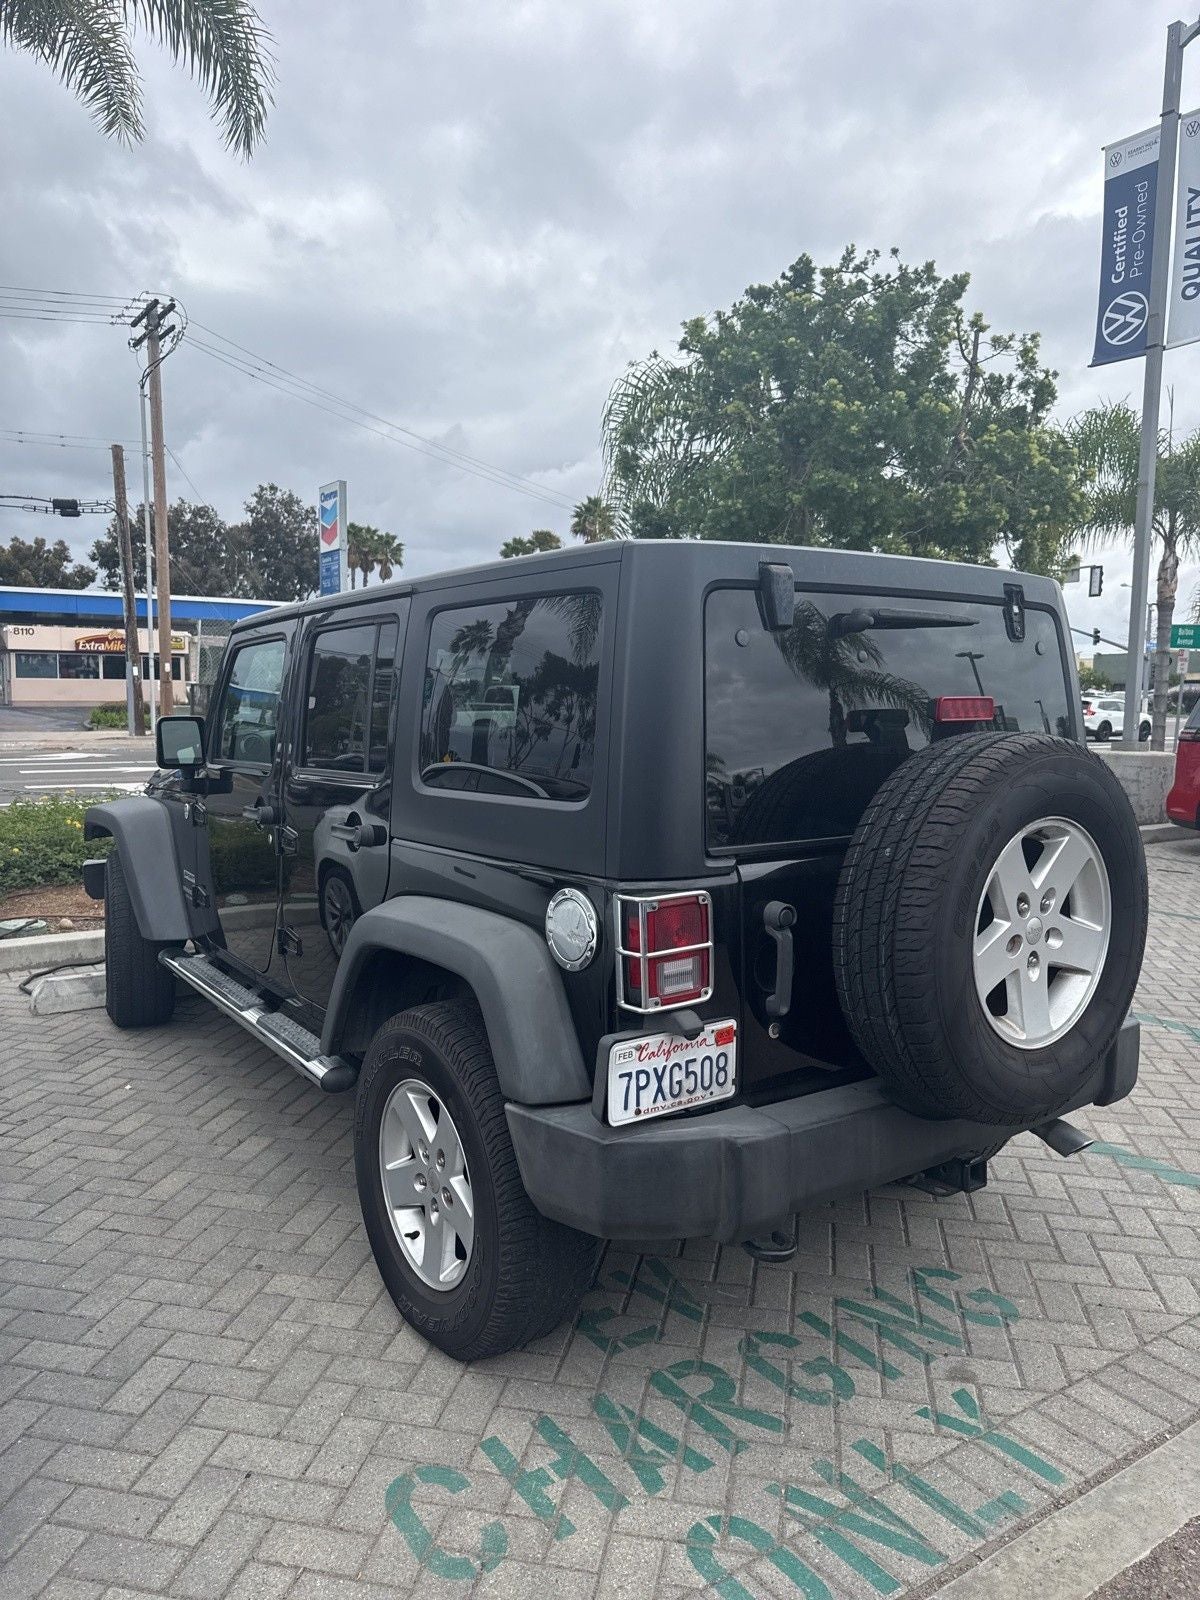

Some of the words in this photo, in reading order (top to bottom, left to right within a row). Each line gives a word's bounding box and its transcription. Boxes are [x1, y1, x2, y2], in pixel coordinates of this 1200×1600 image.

[1111, 206, 1128, 284] Certified
[1129, 181, 1148, 278] Pre-Owned
[1181, 187, 1200, 301] QUALITY
[13, 627, 35, 636] 8110
[78, 640, 126, 651] ExtraMile
[618, 1051, 634, 1061] FEB
[637, 1037, 715, 1063] California
[618, 1052, 729, 1112] 7PXG508
[642, 1093, 708, 1115] dmv.ca.gov
[384, 1266, 1021, 1582] CHARGING
[686, 1388, 1066, 1600] ONLY
